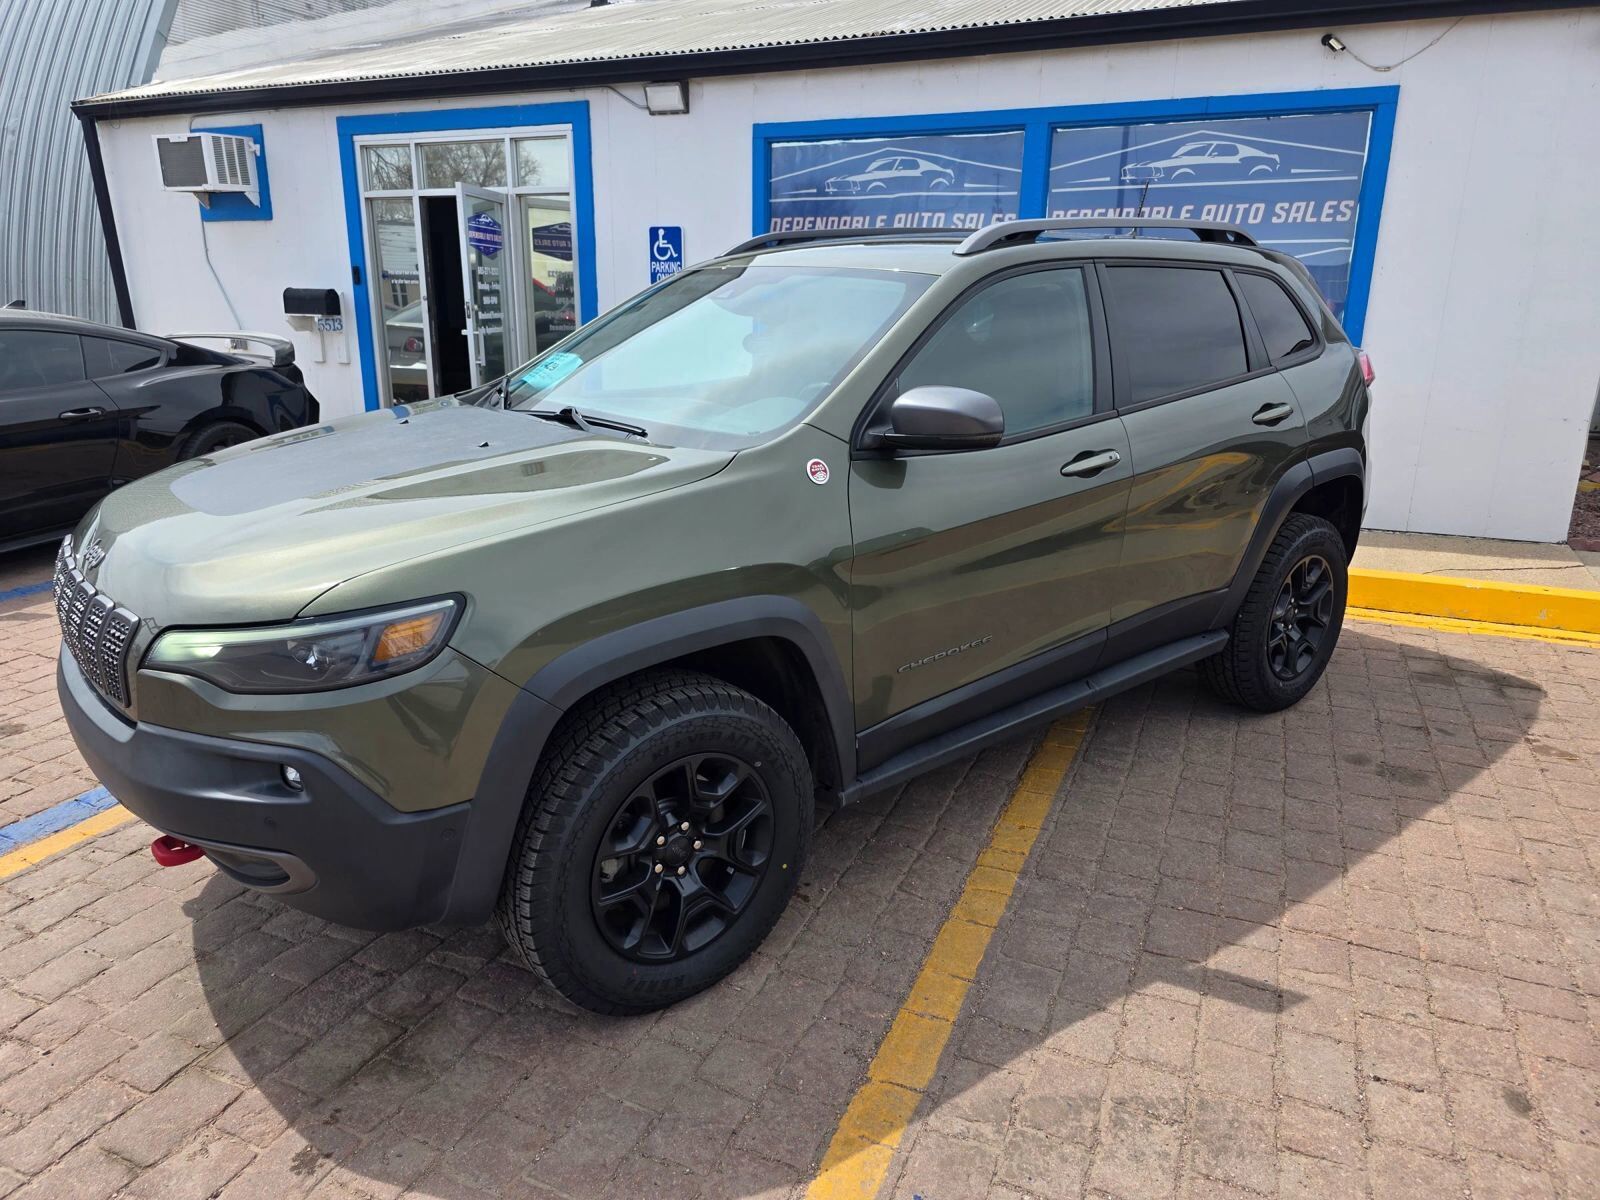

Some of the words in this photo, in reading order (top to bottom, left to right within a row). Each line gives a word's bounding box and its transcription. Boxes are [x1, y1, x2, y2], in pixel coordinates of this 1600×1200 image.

[893, 212, 946, 228] AUTO
[1200, 203, 1265, 225] AUTO
[1271, 200, 1354, 224] SALES
[651, 262, 681, 273] PARKING
[317, 317, 343, 332] 5513
